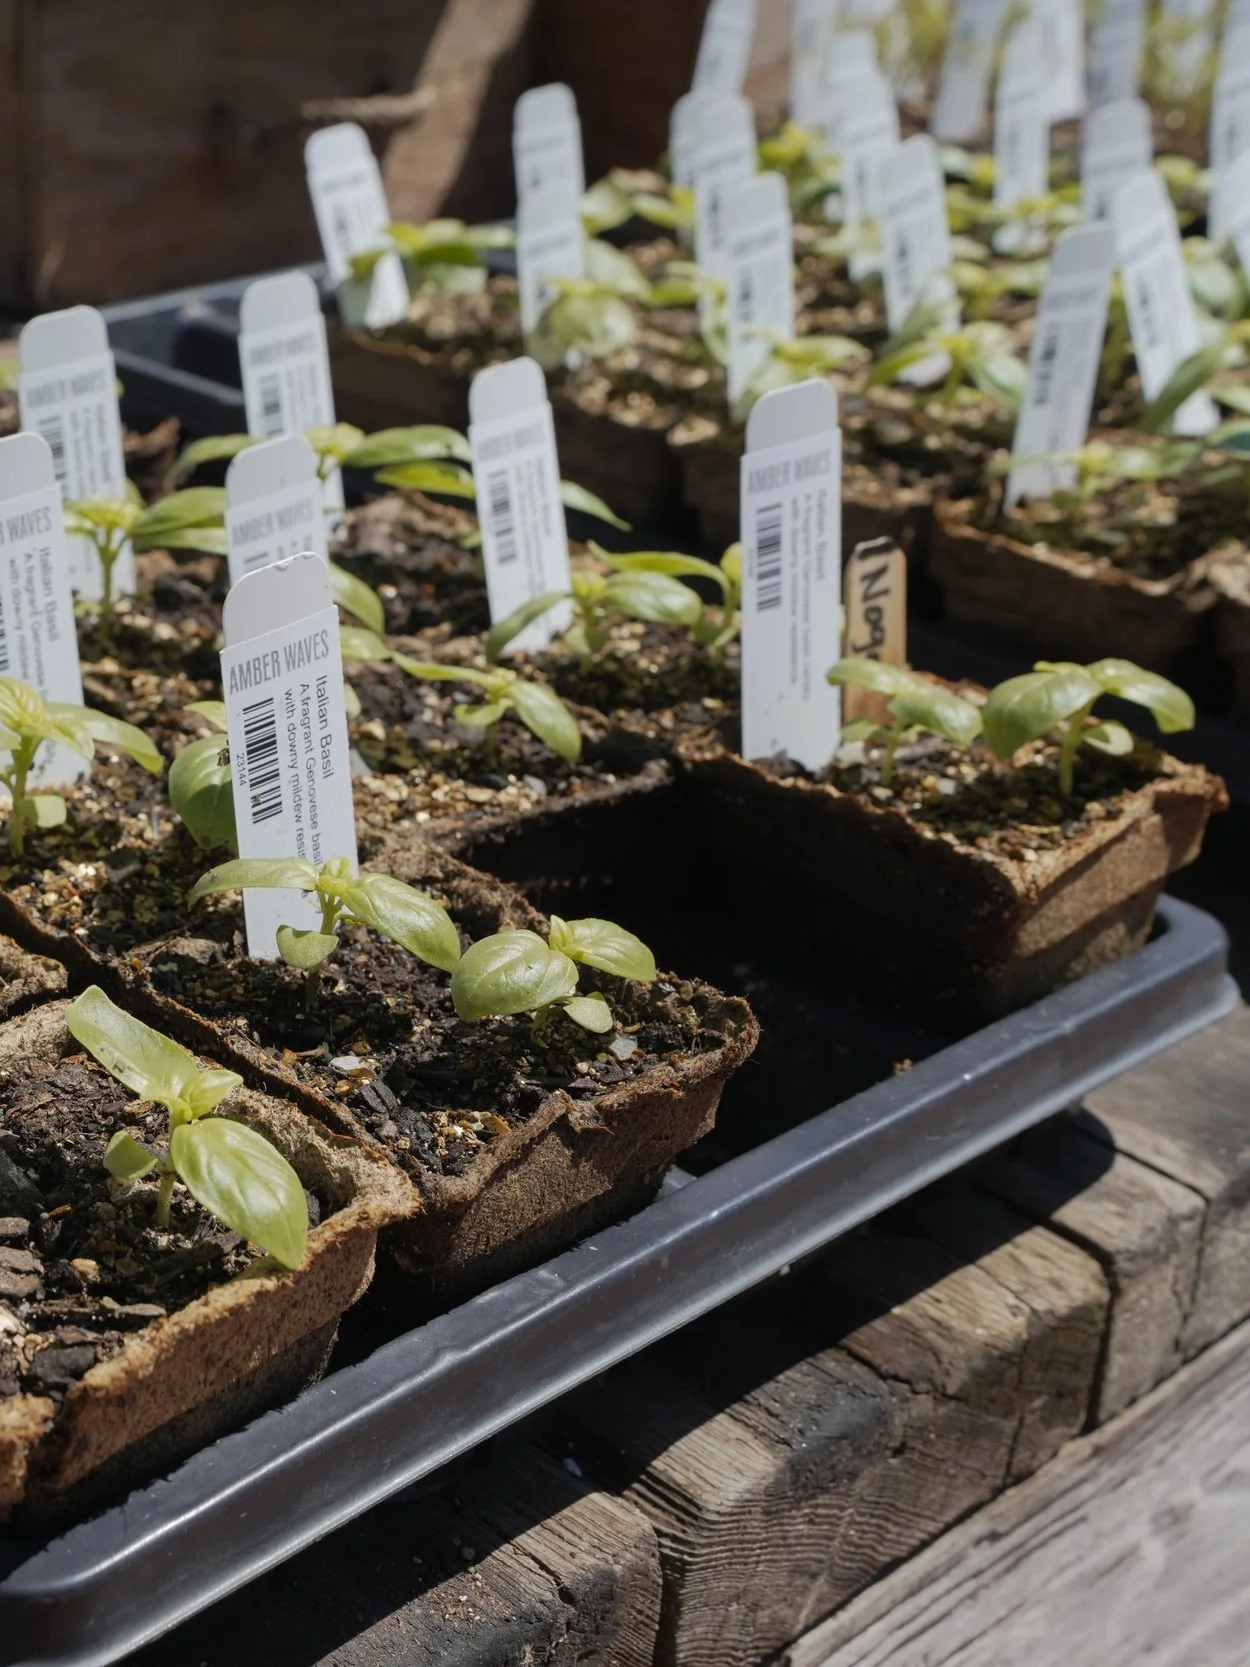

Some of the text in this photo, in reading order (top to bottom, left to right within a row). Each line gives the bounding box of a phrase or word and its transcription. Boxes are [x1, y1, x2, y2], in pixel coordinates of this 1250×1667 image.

[6, 506, 52, 543] WAVES
[230, 629, 329, 695] AMBER WAVES
[284, 688, 296, 720] with
[315, 674, 334, 779] Italian Basil
[236, 753, 247, 786] 23144
[287, 723, 298, 769] downy
[291, 773, 303, 823] mildew
[299, 683, 324, 866] A fragrant Genovese basil
